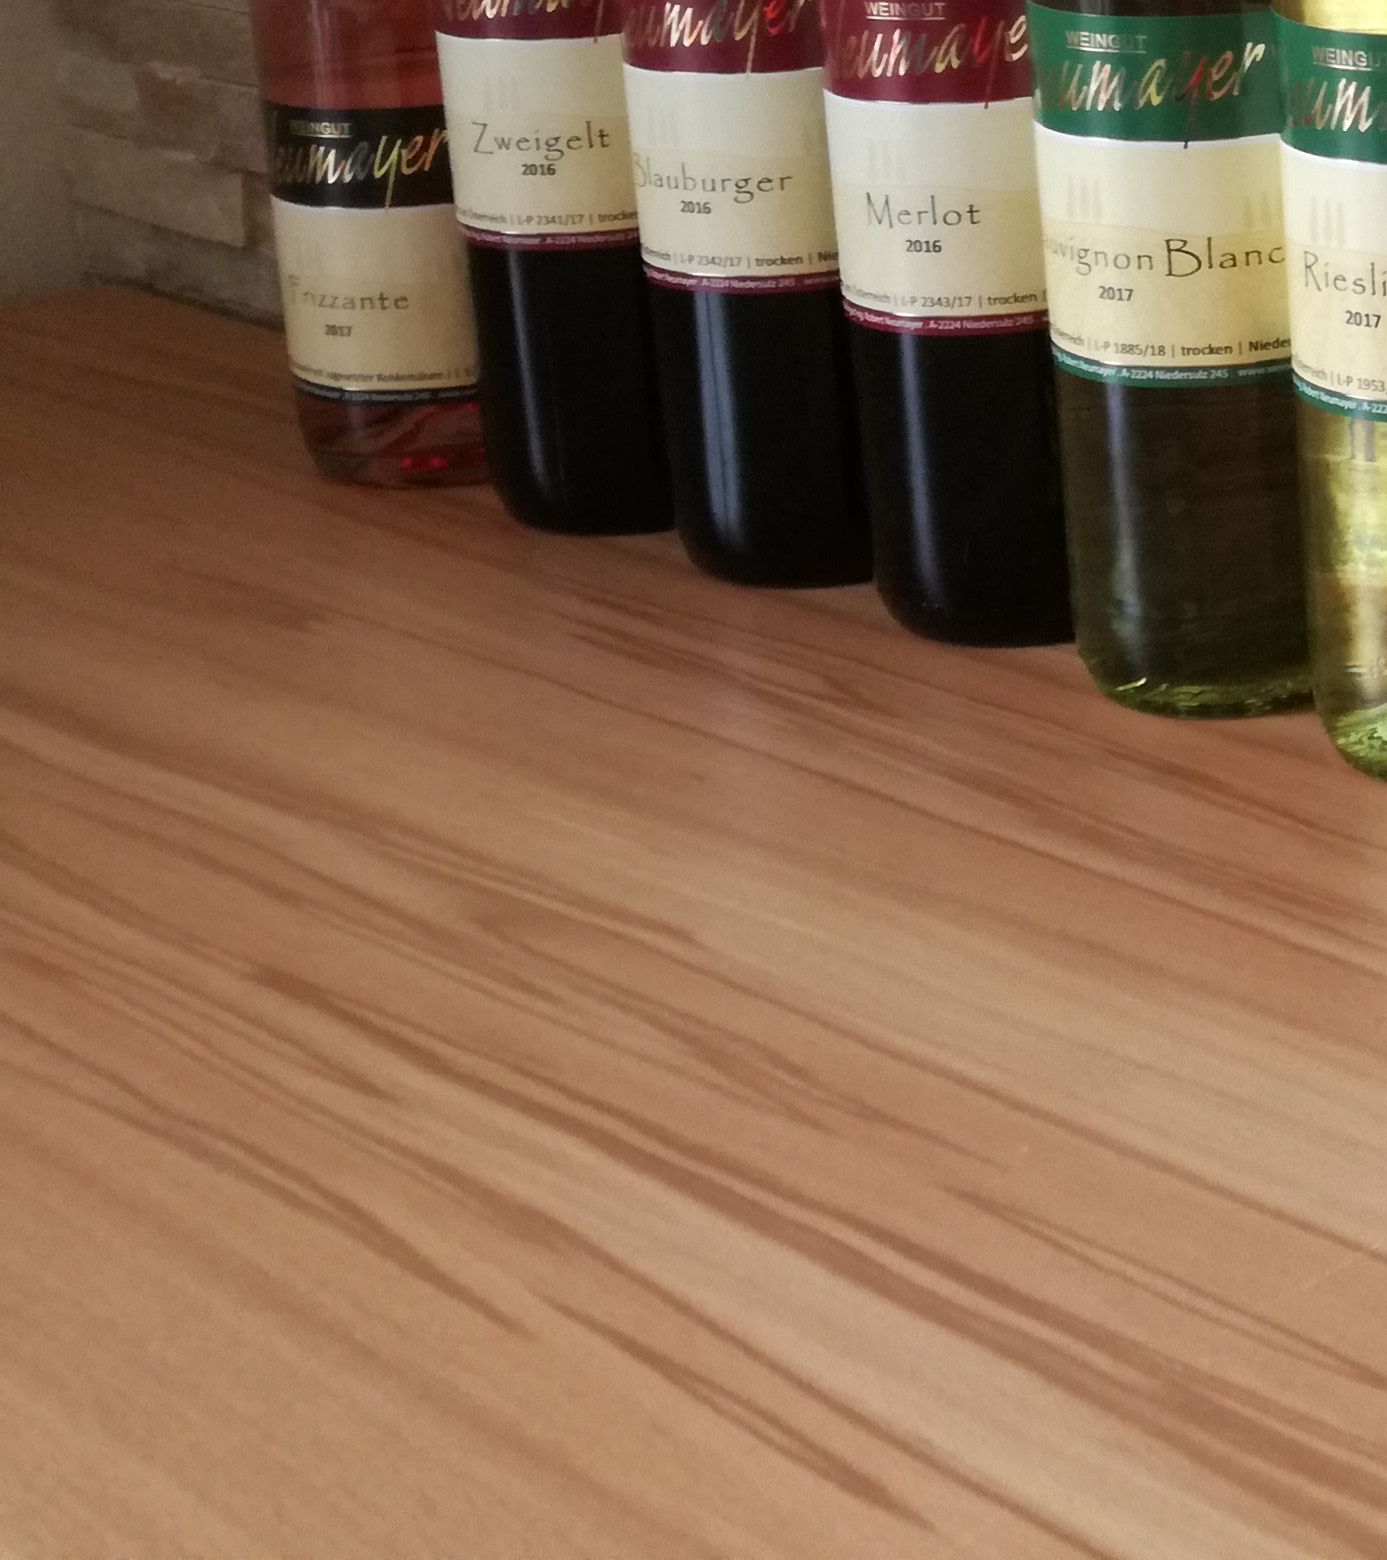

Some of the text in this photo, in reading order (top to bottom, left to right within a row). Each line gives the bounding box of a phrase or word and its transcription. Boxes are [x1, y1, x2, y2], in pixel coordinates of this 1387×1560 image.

[864, 1, 946, 17] WEINGUT
[471, 120, 611, 162] Zweigelt
[521, 163, 556, 176] 2016
[680, 200, 712, 215] 2016
[866, 192, 981, 229] Merlot
[905, 239, 942, 253] 2016
[754, 255, 804, 267] trocken
[1164, 237, 1286, 278] Blanc
[987, 293, 1037, 306] trocken
[1098, 285, 1134, 302] 2017
[1345, 310, 1382, 329] 2017
[1113, 343, 1166, 357] 1885/18
[1180, 342, 1233, 356] trocken
